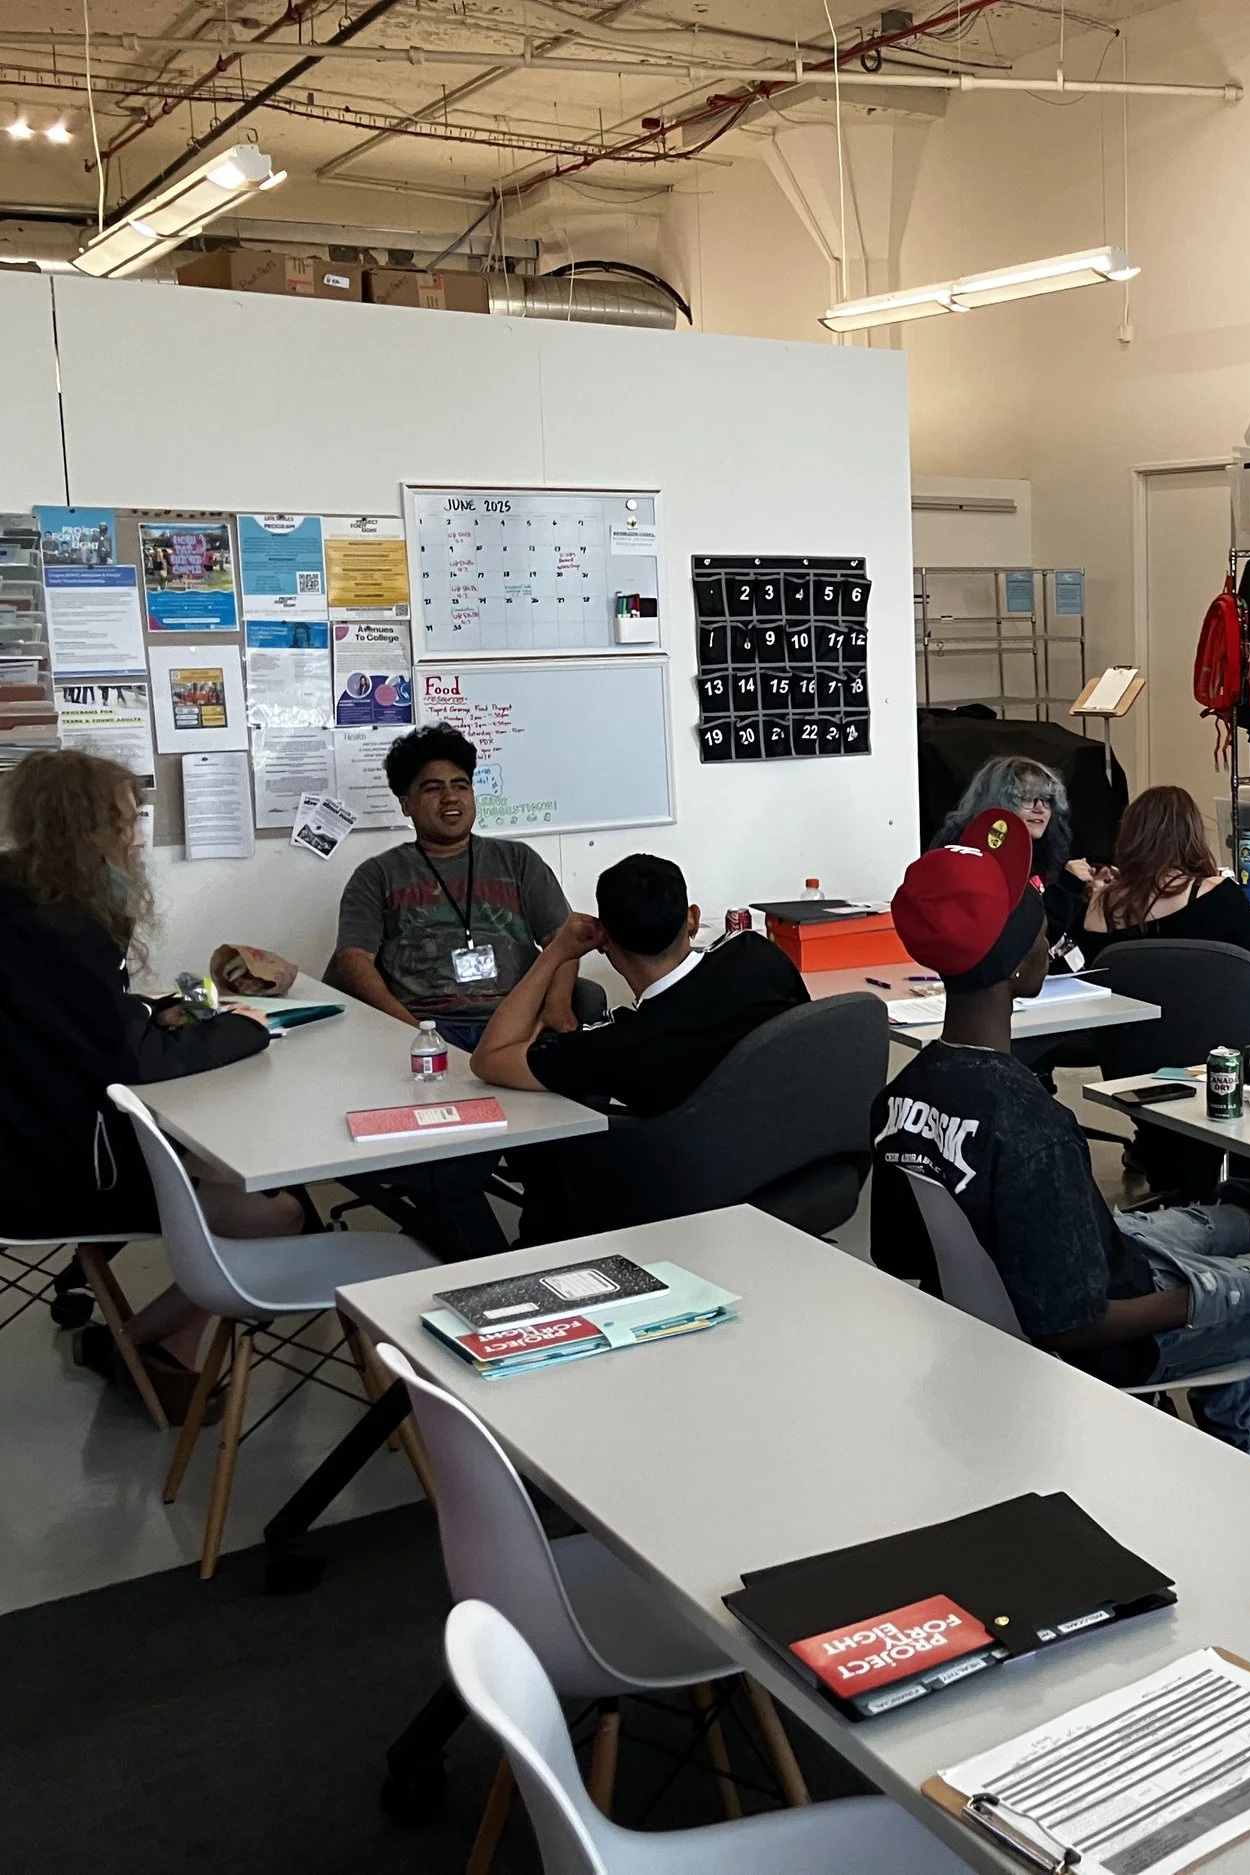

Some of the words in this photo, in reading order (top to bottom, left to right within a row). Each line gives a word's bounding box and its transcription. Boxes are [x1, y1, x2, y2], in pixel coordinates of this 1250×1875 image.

[444, 499, 476, 511] JUNE
[484, 500, 511, 513] 2025
[740, 586, 750, 600] 2
[765, 585, 774, 600] 3
[824, 586, 834, 600] 5
[851, 588, 862, 601] 6
[366, 634, 399, 643] College
[765, 631, 775, 645] 9
[791, 633, 808, 649] 10
[828, 633, 845, 649] 11
[851, 632, 866, 645] 12
[425, 676, 461, 695] Food
[704, 680, 723, 696] 13
[738, 678, 755, 693] 14
[770, 679, 789, 694] 15
[800, 680, 815, 693] 16
[704, 729, 723, 746] 19
[739, 728, 755, 745] 20
[802, 725, 818, 739] 22
[521, 1320, 583, 1341] FORTY
[484, 1330, 568, 1353] PROJECT
[822, 1622, 897, 1656] EIGHT
[884, 1614, 962, 1650] FORTY
[837, 1633, 948, 1680] PROJECT
